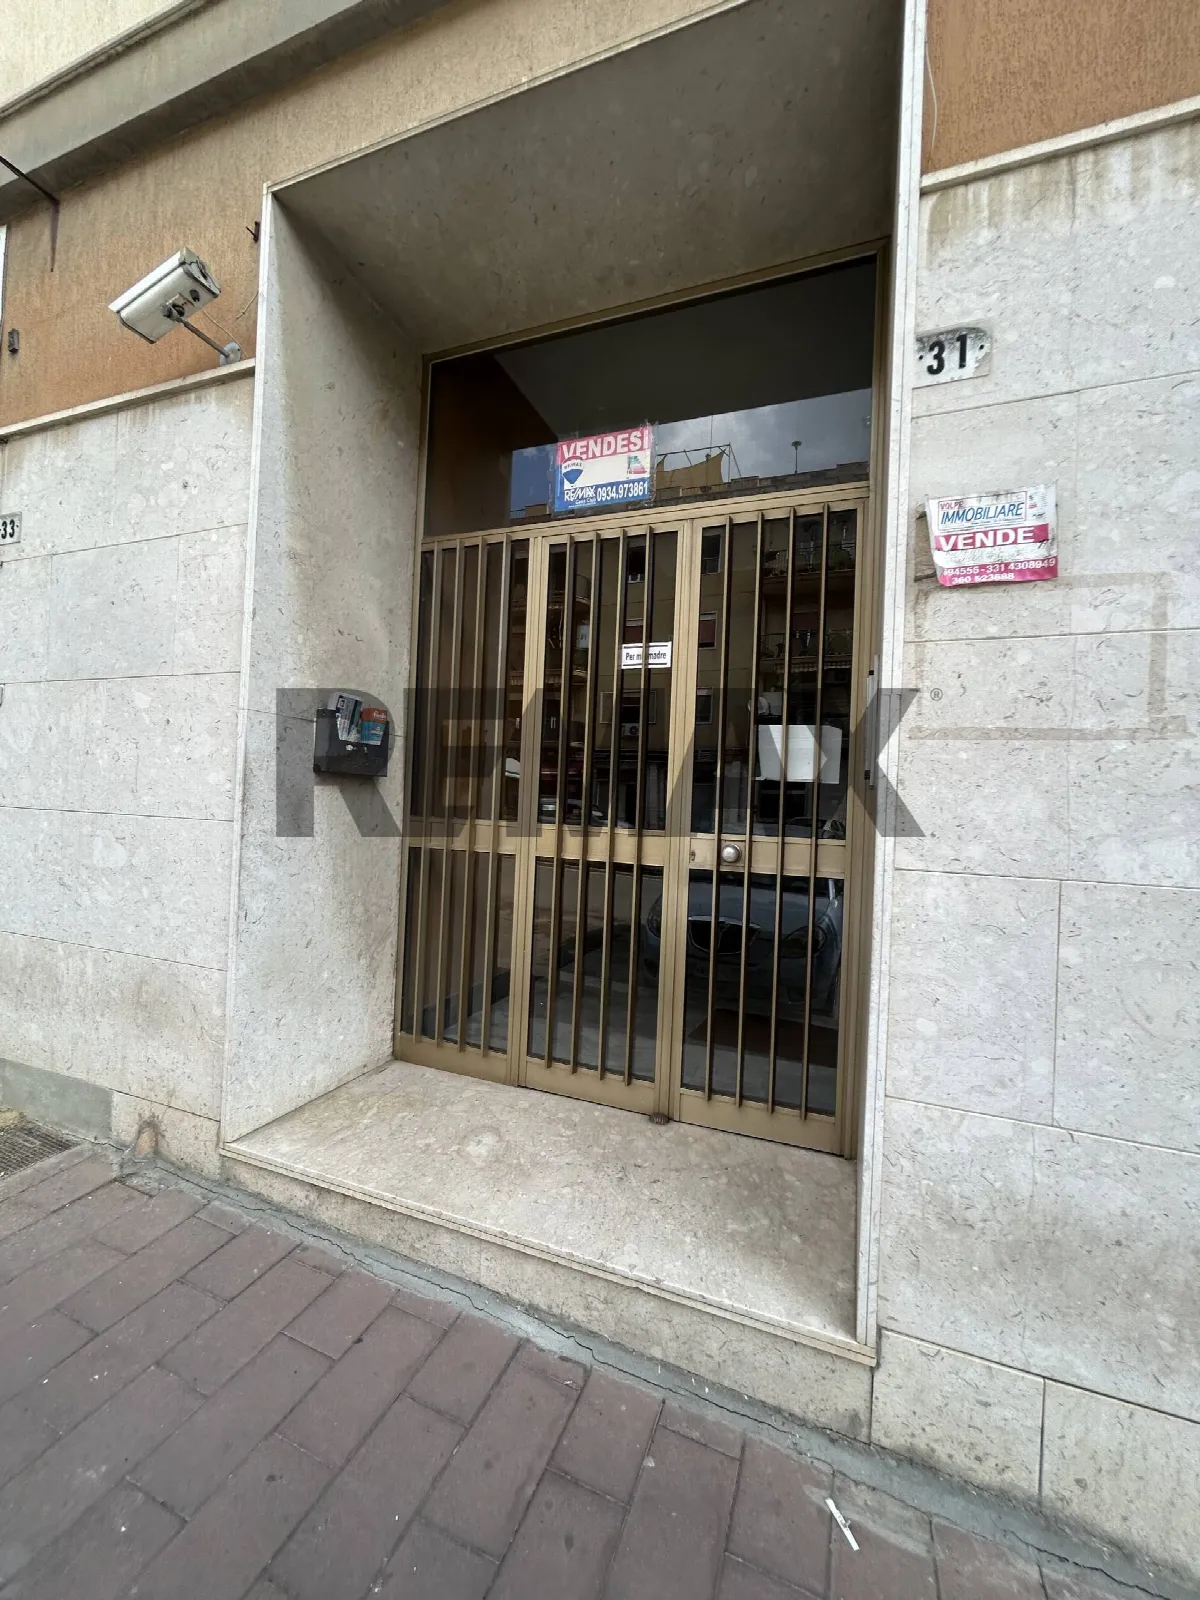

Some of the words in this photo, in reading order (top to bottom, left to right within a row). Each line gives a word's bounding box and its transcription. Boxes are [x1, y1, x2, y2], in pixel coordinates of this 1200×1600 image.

[927, 333, 967, 375] 31
[562, 429, 649, 460] VENDESI
[597, 481, 648, 501] 0934.973861
[940, 501, 964, 510] VOLPE
[941, 502, 1025, 525] IMMOBILIARE
[1, 519, 15, 539] 33
[939, 527, 1035, 551] VENDE
[952, 576, 972, 585] 360
[625, 653, 635, 661] Per
